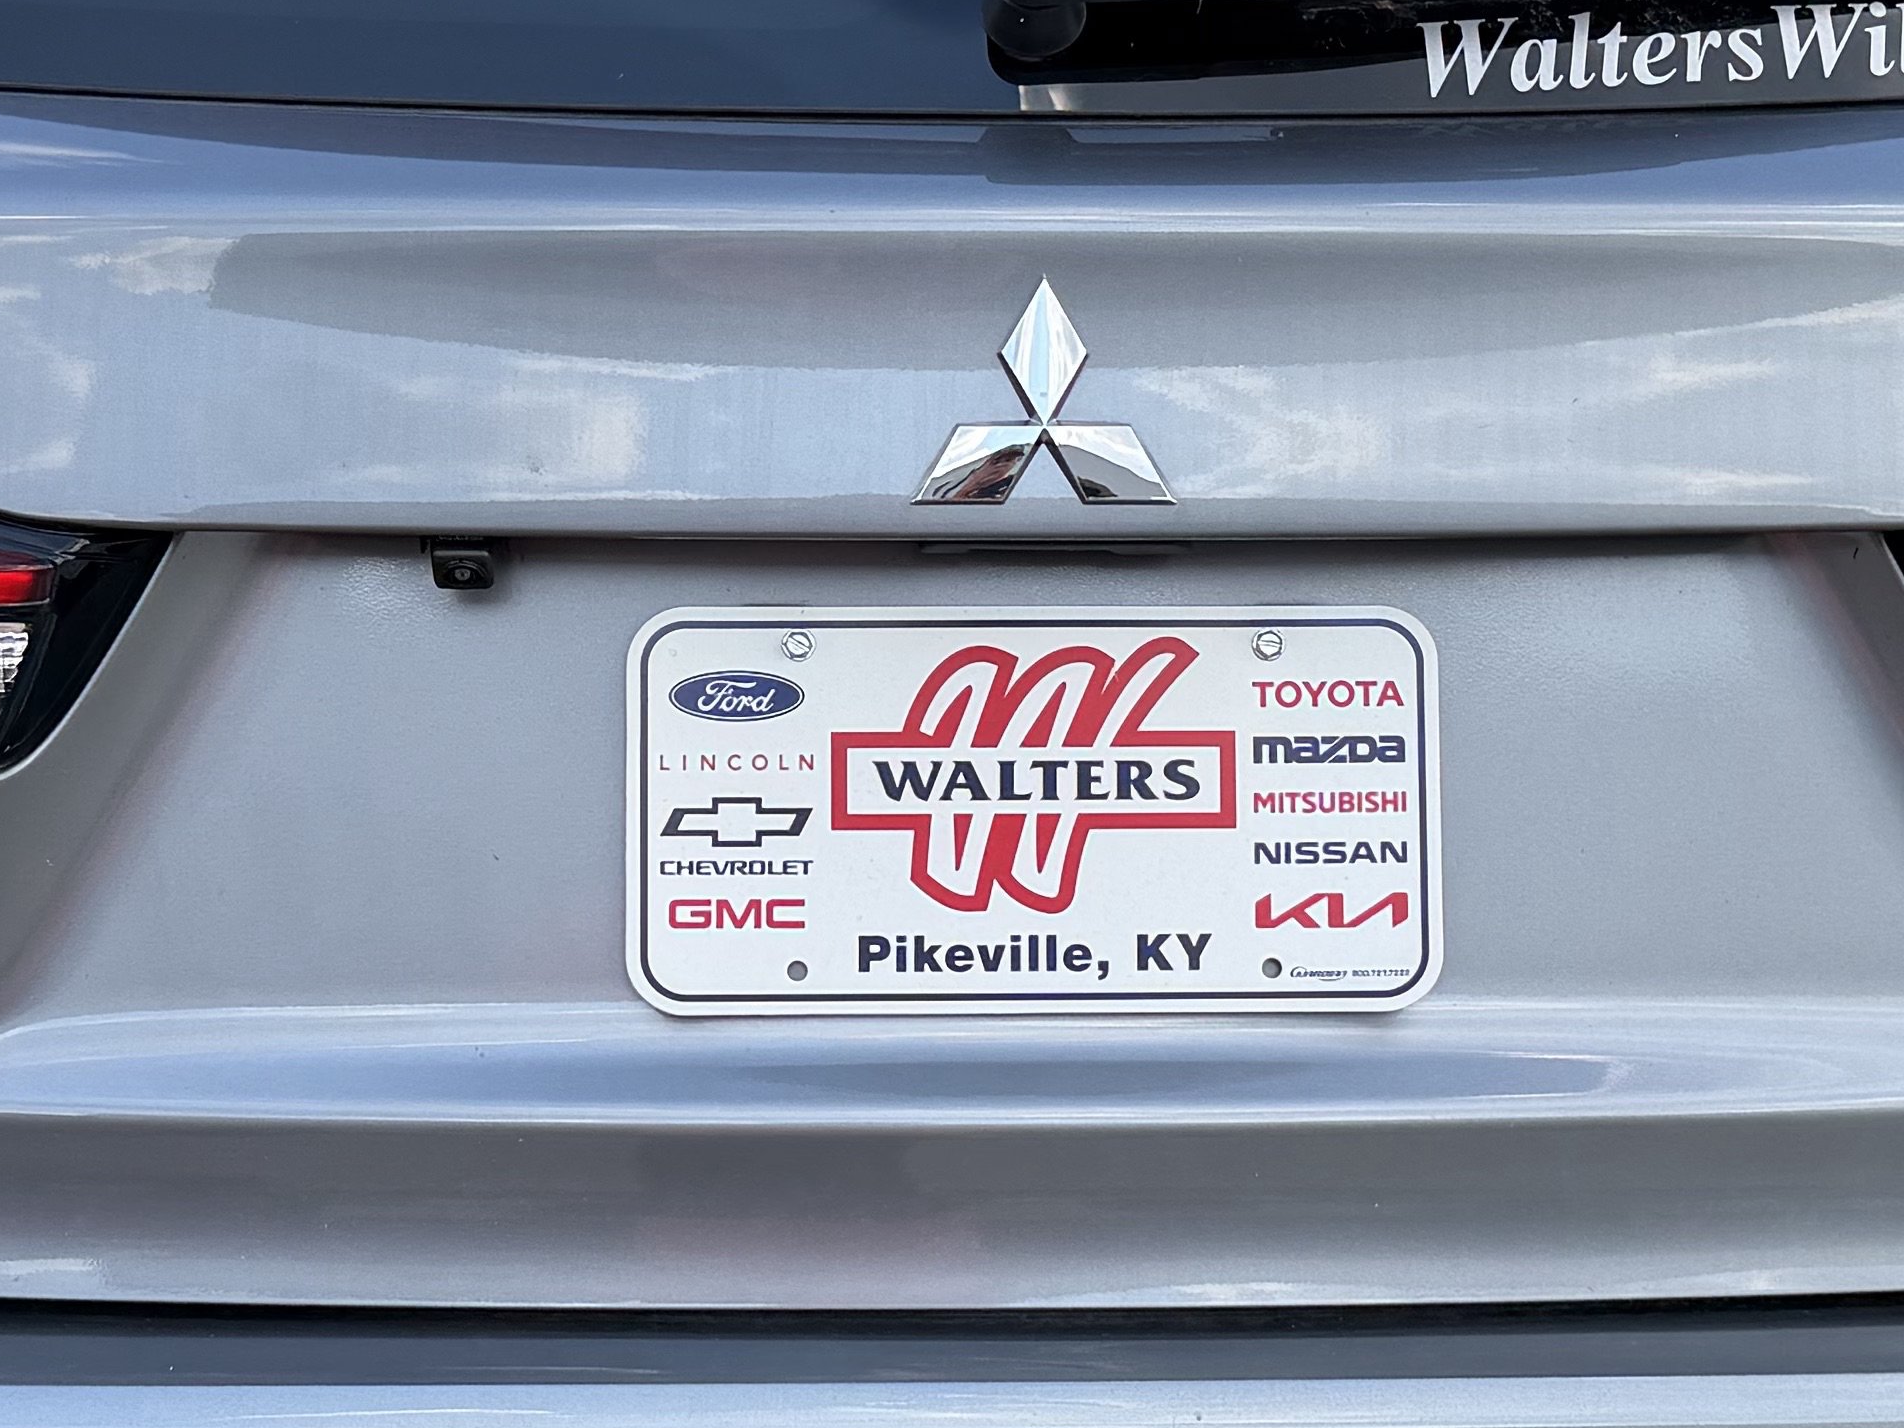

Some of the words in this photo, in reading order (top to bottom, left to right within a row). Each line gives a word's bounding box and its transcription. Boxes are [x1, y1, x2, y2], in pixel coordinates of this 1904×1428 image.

[696, 679, 777, 713] Ford
[1251, 679, 1405, 708] TOYOTA
[659, 753, 815, 772] LINCOLN
[871, 758, 1202, 803] WALTERS
[1253, 790, 1408, 814] MITSUBISHI
[659, 859, 815, 876] CHEVROLET
[1253, 840, 1409, 865] NISSAN
[668, 898, 806, 930] GMC
[1255, 891, 1409, 929] KIA
[857, 933, 1111, 981] Pikeville,
[1135, 932, 1213, 972] KY
